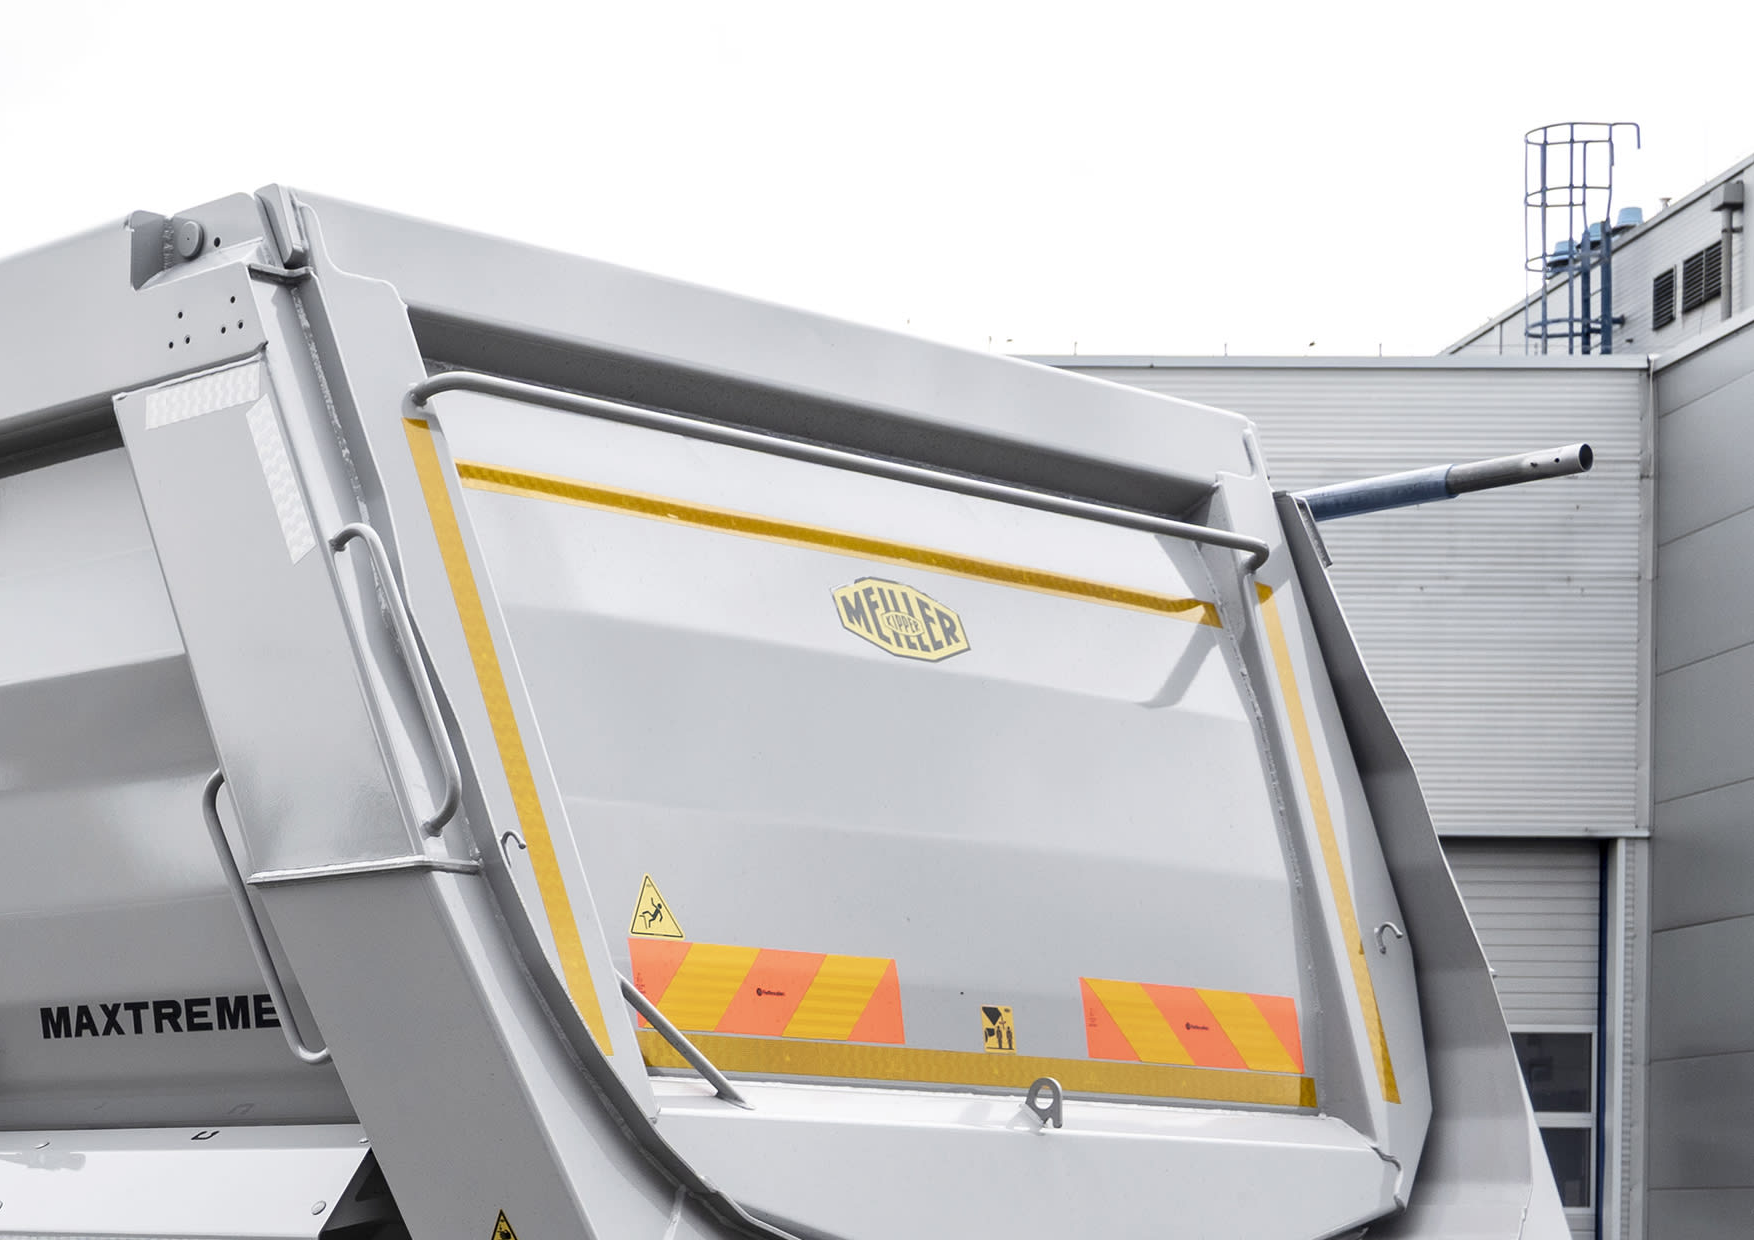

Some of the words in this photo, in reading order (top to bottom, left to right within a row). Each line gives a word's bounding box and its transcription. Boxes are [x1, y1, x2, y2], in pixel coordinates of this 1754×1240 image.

[840, 586, 961, 653] MEILLER
[886, 613, 921, 634] KIPPER
[40, 994, 282, 1039] MAXTREME
